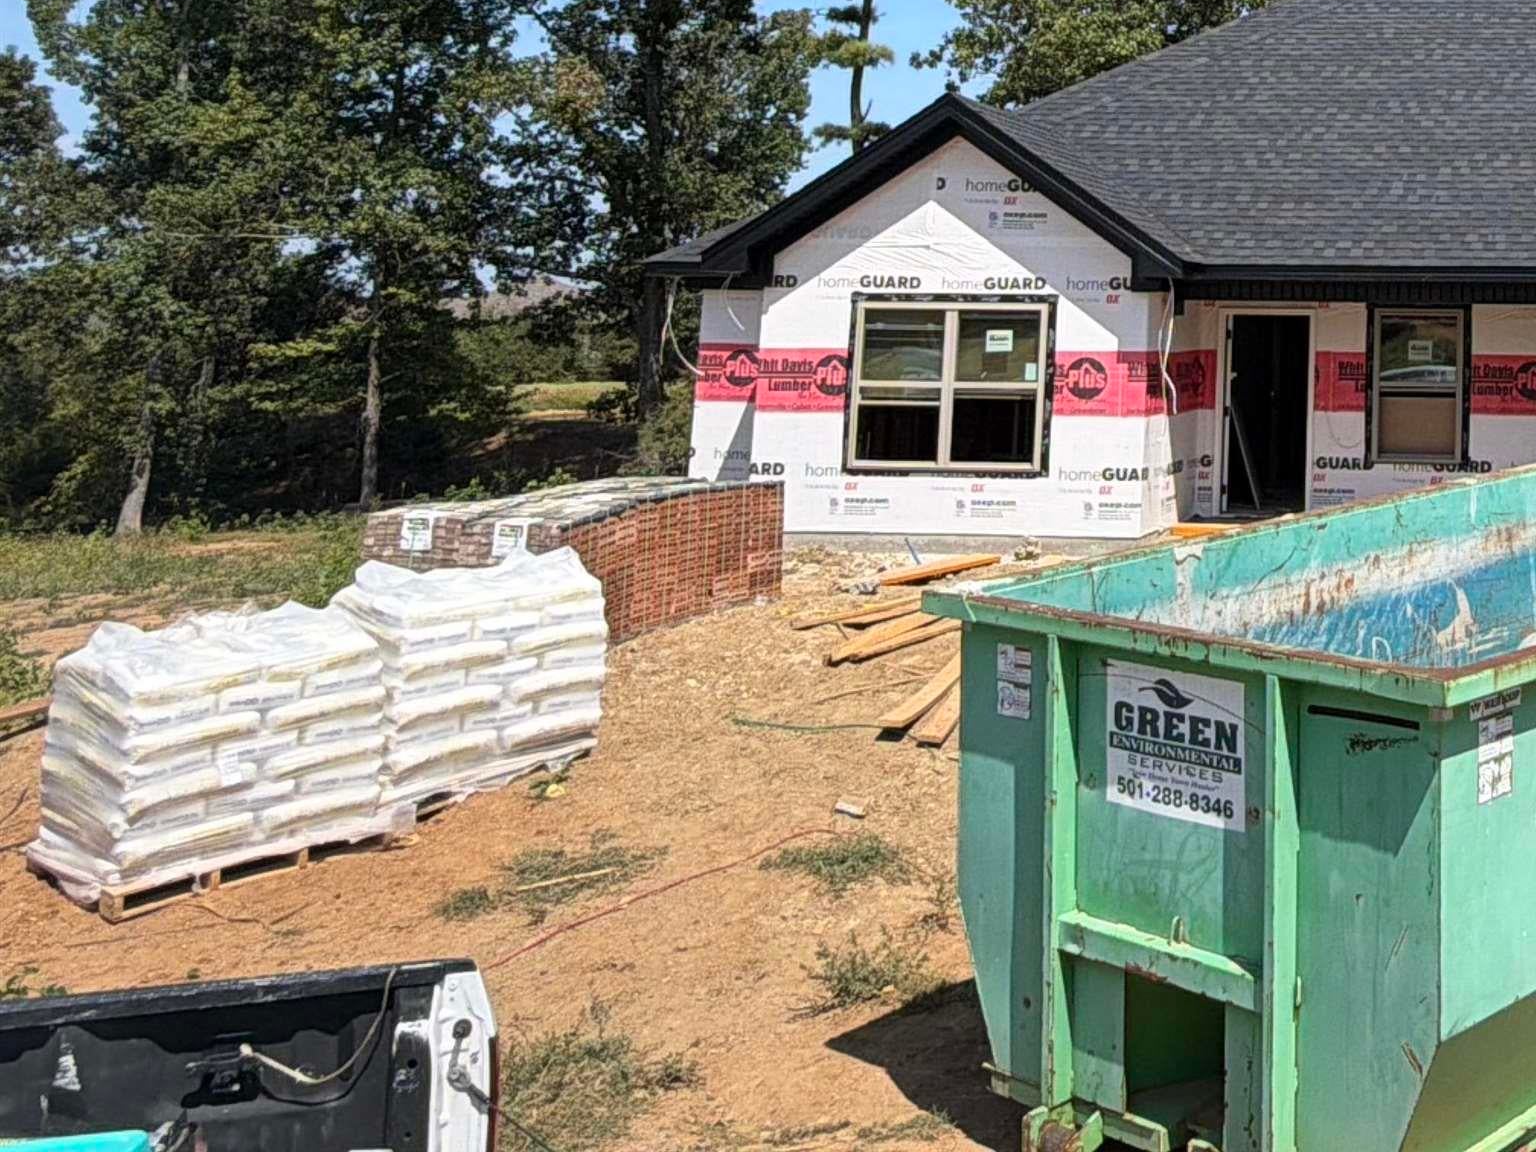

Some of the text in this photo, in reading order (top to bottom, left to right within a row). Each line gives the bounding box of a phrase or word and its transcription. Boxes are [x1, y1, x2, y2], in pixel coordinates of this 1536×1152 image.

[768, 379, 813, 392] Lumber
[1068, 362, 1107, 390] Plus
[804, 463, 842, 477] hom
[1114, 700, 1239, 755] GREEN
[1112, 733, 1240, 773] ENVIRONMENTAL
[1127, 752, 1224, 784] SERVICES
